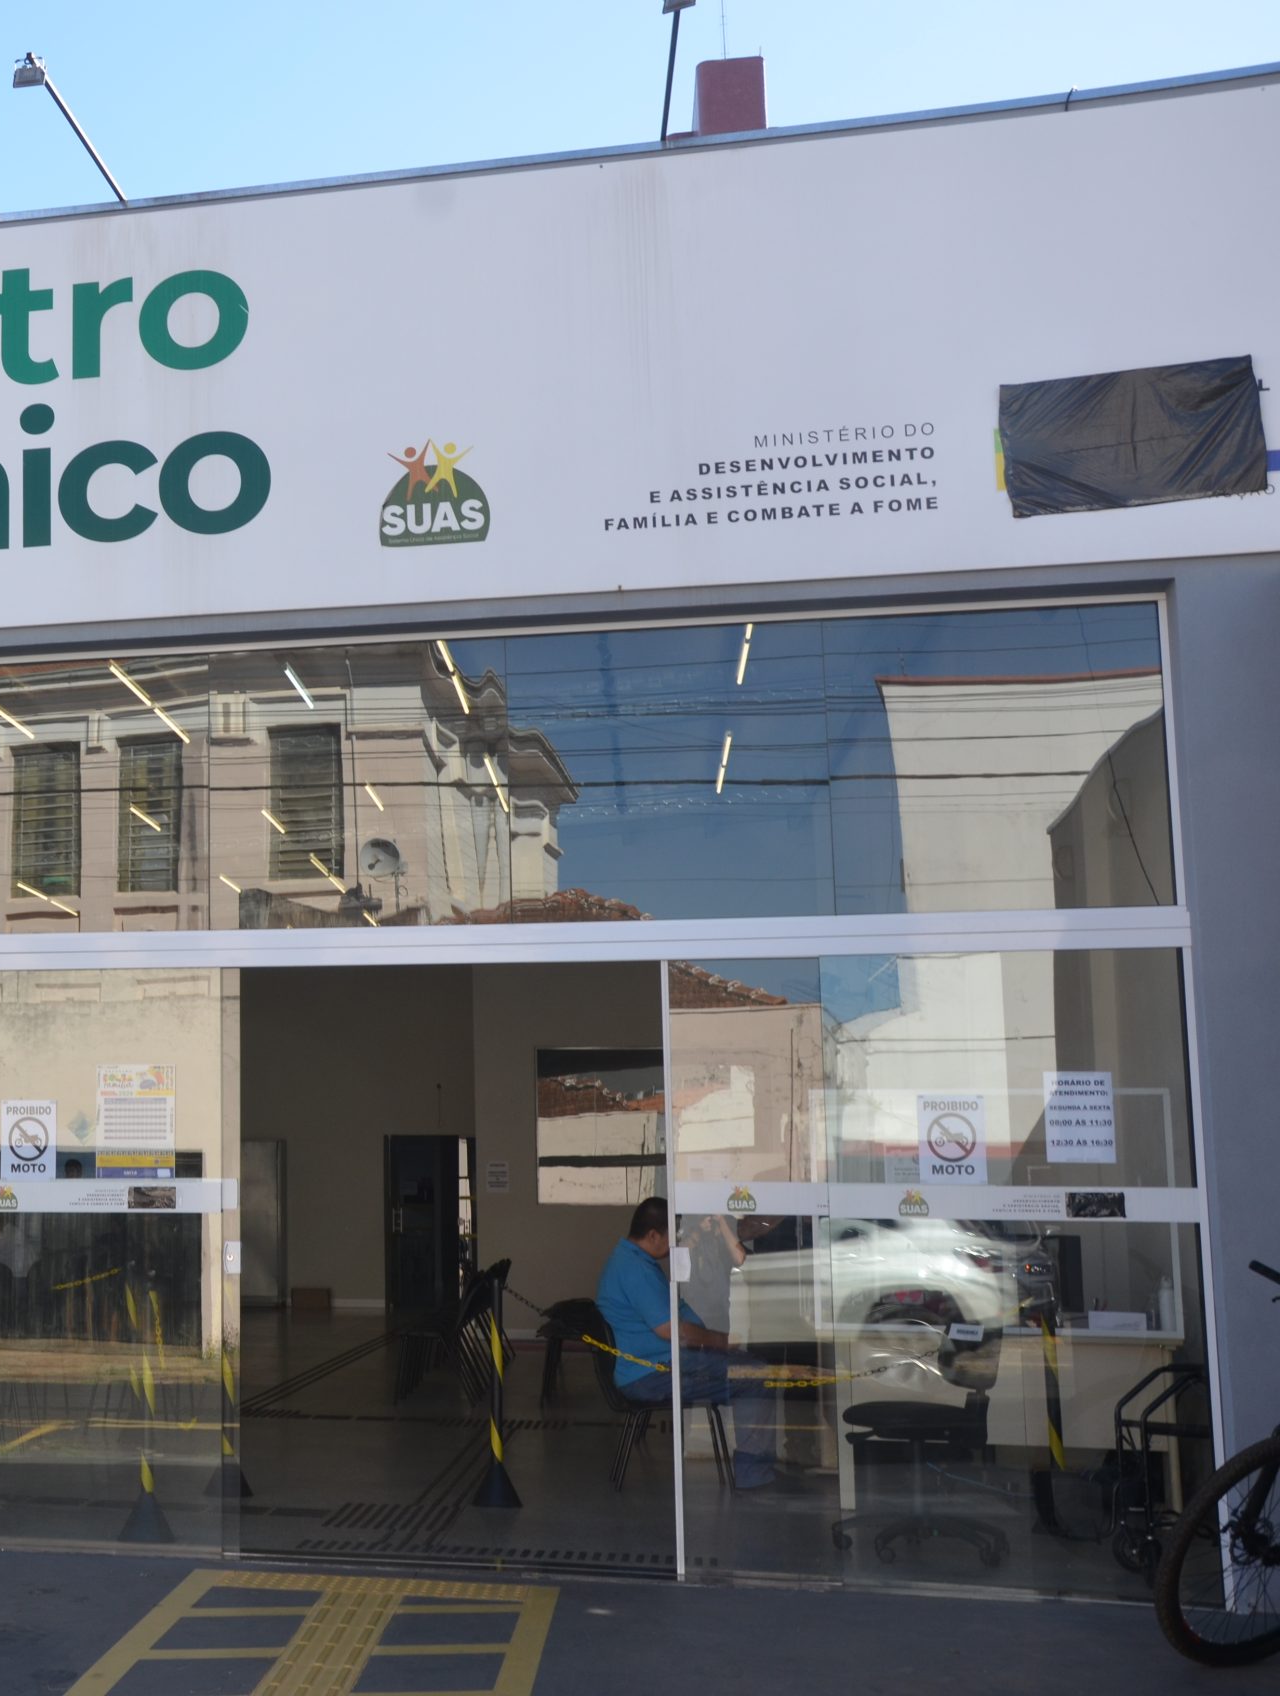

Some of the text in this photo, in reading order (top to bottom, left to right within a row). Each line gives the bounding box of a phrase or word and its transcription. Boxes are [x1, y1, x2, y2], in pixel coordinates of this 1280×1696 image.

[753, 422, 935, 449] MINISTÉRIO DO
[698, 446, 935, 475] DESENVOLVIMENTO
[649, 472, 937, 504] E ASSISTÊNCIA SOCIAL,
[381, 498, 485, 536] SUAS
[604, 496, 939, 531] FAMÍLIA E COMBATE A FOME
[1093, 1079, 1105, 1087] DE
[6, 1105, 52, 1115] PROIBIDO
[923, 1100, 979, 1111] PROIBIDO
[10, 1163, 47, 1173] MOTO
[931, 1164, 975, 1175] MOTO
[728, 1200, 756, 1210] SUAS
[899, 1204, 928, 1213] SUAS
